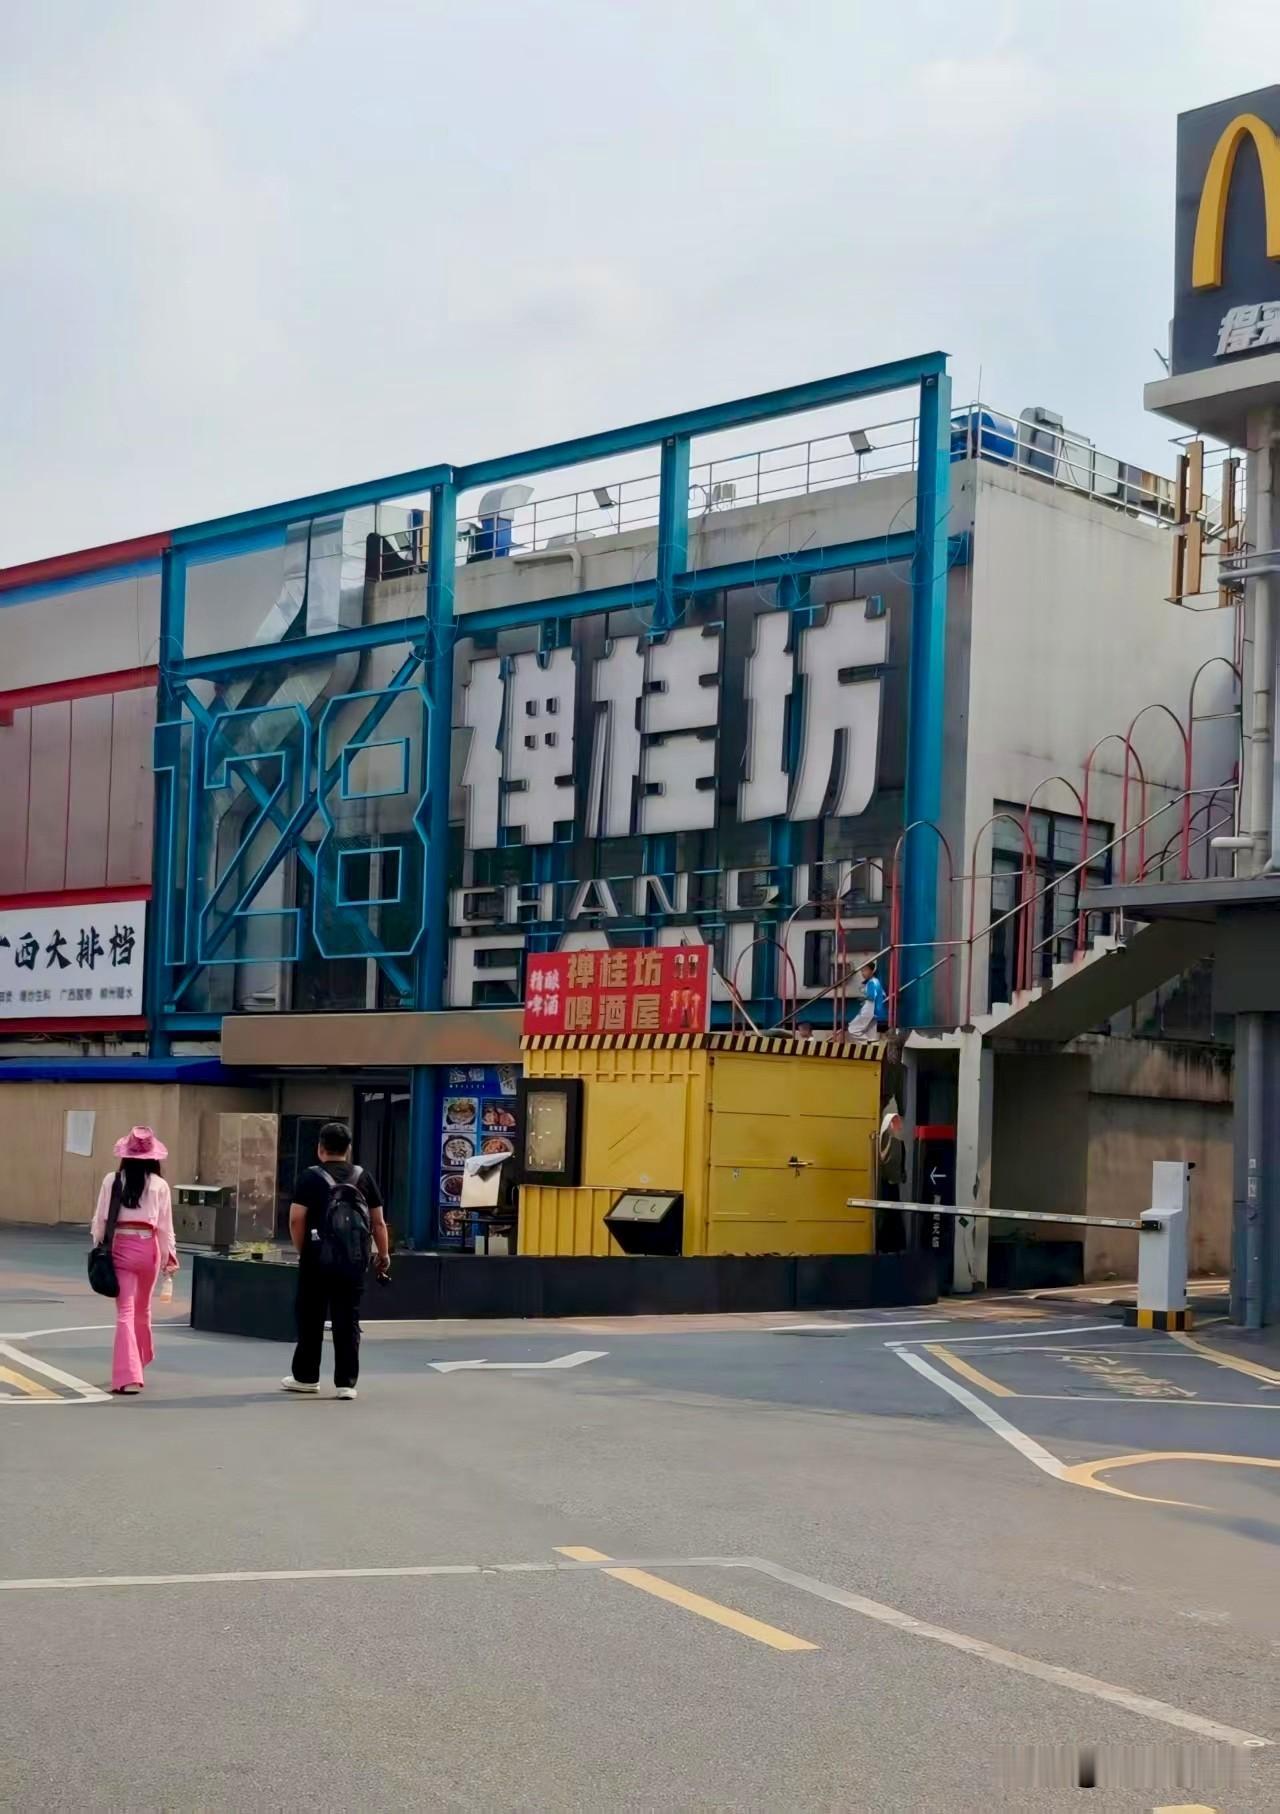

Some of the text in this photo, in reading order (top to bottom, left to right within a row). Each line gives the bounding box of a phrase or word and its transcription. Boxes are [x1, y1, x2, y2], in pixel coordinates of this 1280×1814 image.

[153, 685, 435, 965] 128
[528, 968, 560, 992] 精酿
[526, 993, 559, 1017] 啤酒
[564, 993, 661, 1031] 啤酒屋
